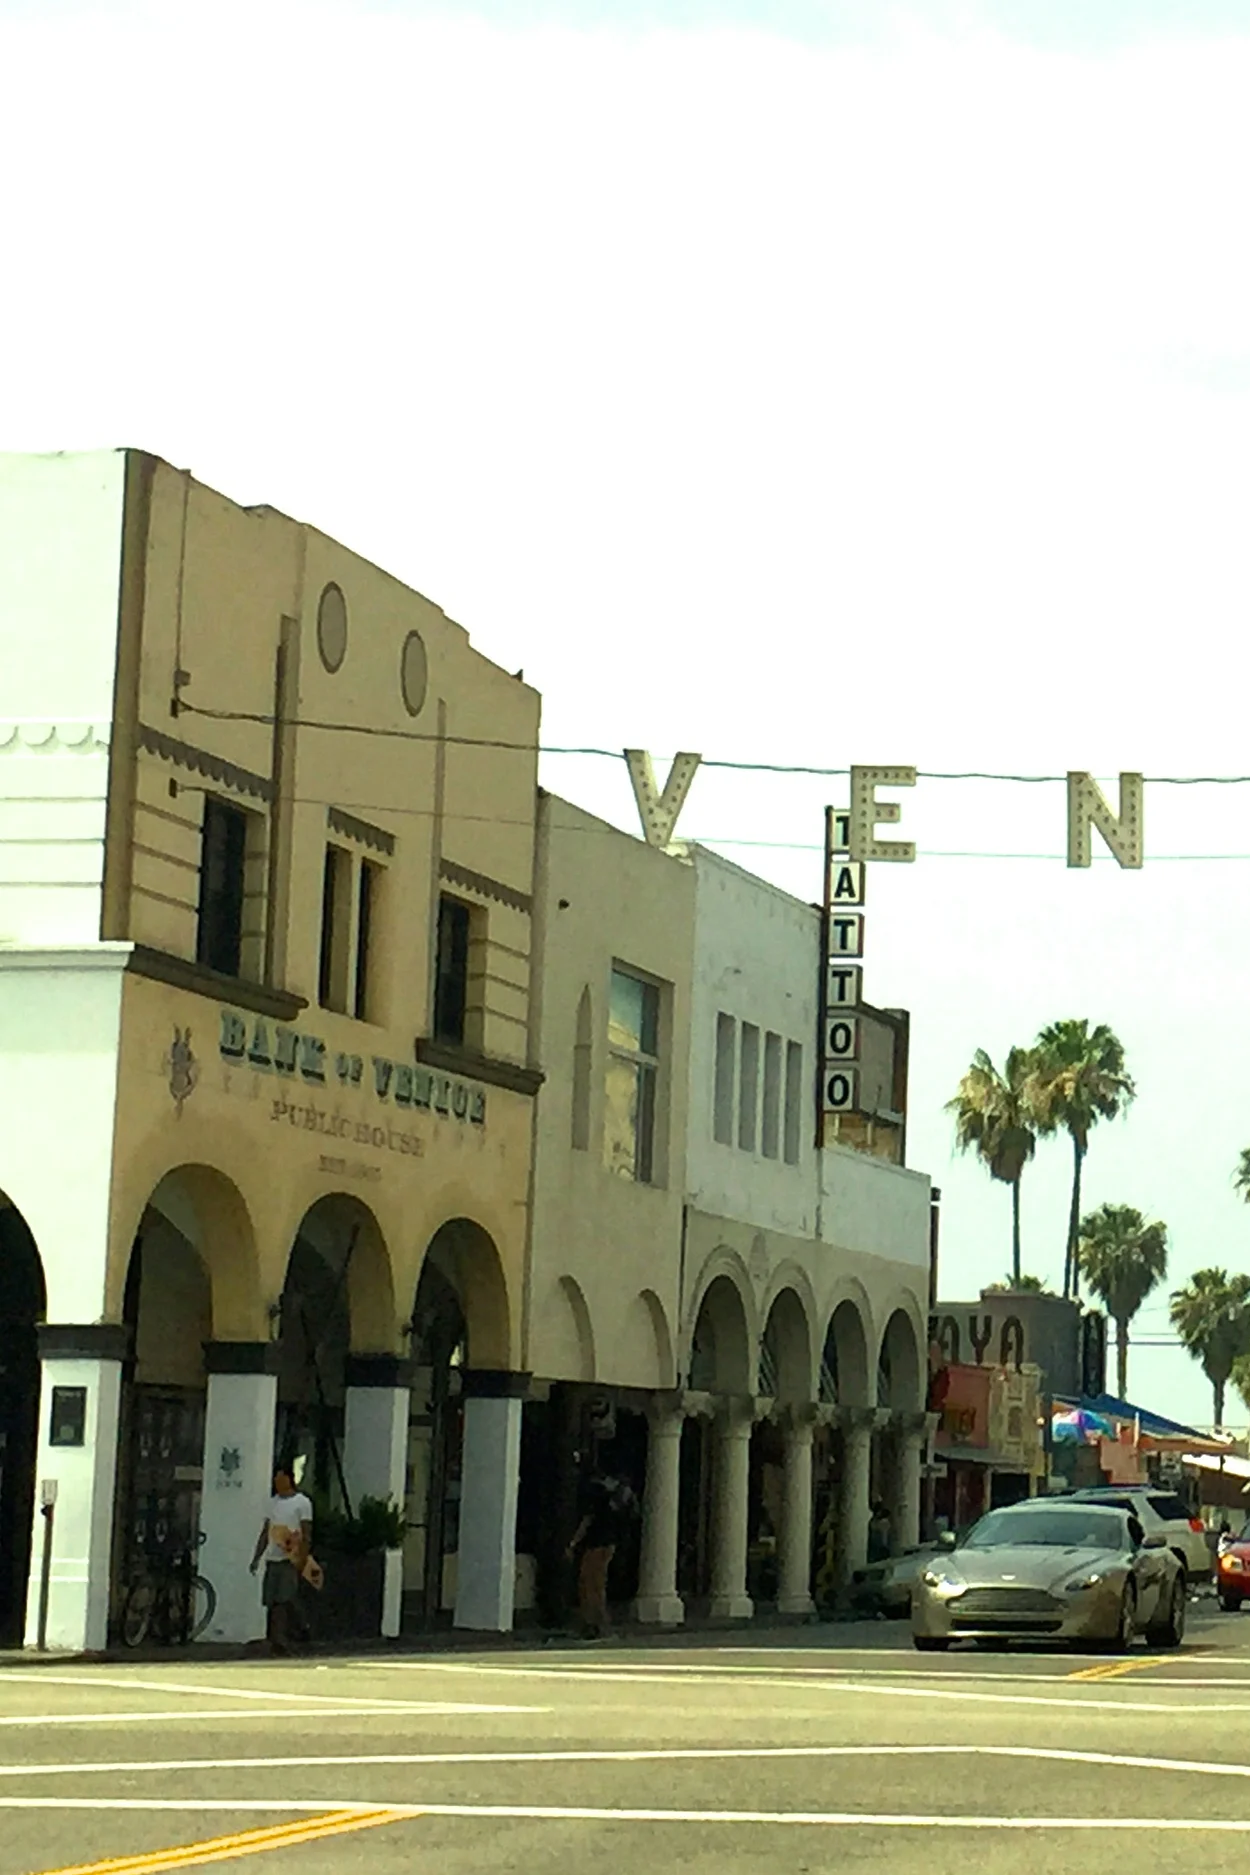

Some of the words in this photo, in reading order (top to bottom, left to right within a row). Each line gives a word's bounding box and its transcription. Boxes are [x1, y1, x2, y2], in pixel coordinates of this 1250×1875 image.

[827, 815, 856, 1107] TATTOO
[219, 1010, 326, 1084] BANK
[371, 1055, 487, 1127] VENICE
[271, 1099, 348, 1139] PUBLIC
[353, 1126, 425, 1157] HOUSE
